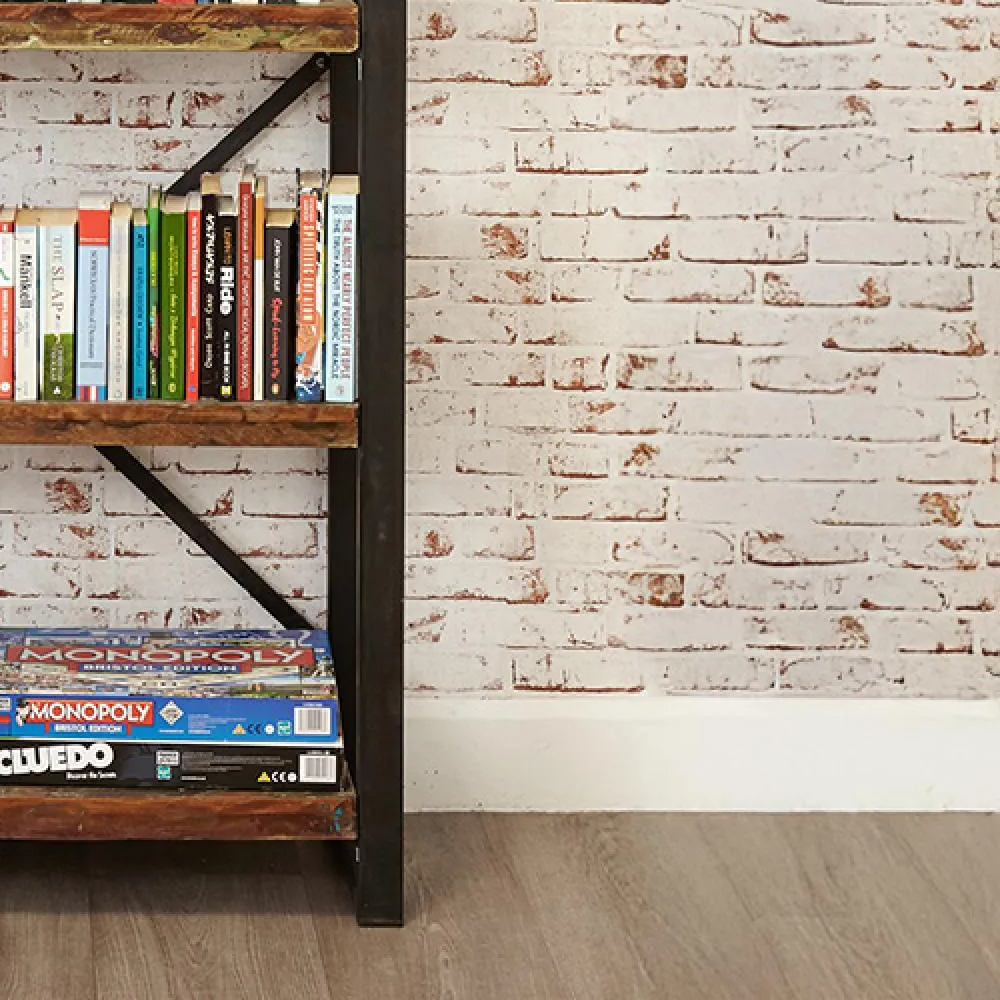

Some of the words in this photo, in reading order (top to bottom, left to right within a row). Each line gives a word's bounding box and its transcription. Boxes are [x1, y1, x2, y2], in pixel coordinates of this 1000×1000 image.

[333, 219, 341, 233] THE
[342, 219, 352, 233] THE
[52, 235, 63, 262] THE
[332, 235, 341, 260] TRUTH
[342, 236, 352, 268] ALMOST
[19, 253, 33, 309] Mankell
[51, 265, 65, 312] SLAP
[332, 262, 341, 290] ABOUT
[342, 272, 352, 303] NEARLY
[219, 266, 235, 316] Ride
[332, 293, 341, 306] THE
[332, 309, 341, 342] NORDIC
[342, 305, 352, 344] PERFECT
[332, 343, 341, 379] MIRACLE
[341, 346, 352, 379] PEOPLE
[19, 649, 303, 664] MONOPOLY
[82, 663, 154, 672] BRISTOL
[162, 664, 238, 673] EDITION
[30, 702, 151, 722] MONOPOLY
[53, 724, 87, 733] BRISTOL
[88, 725, 123, 734] EDITION
